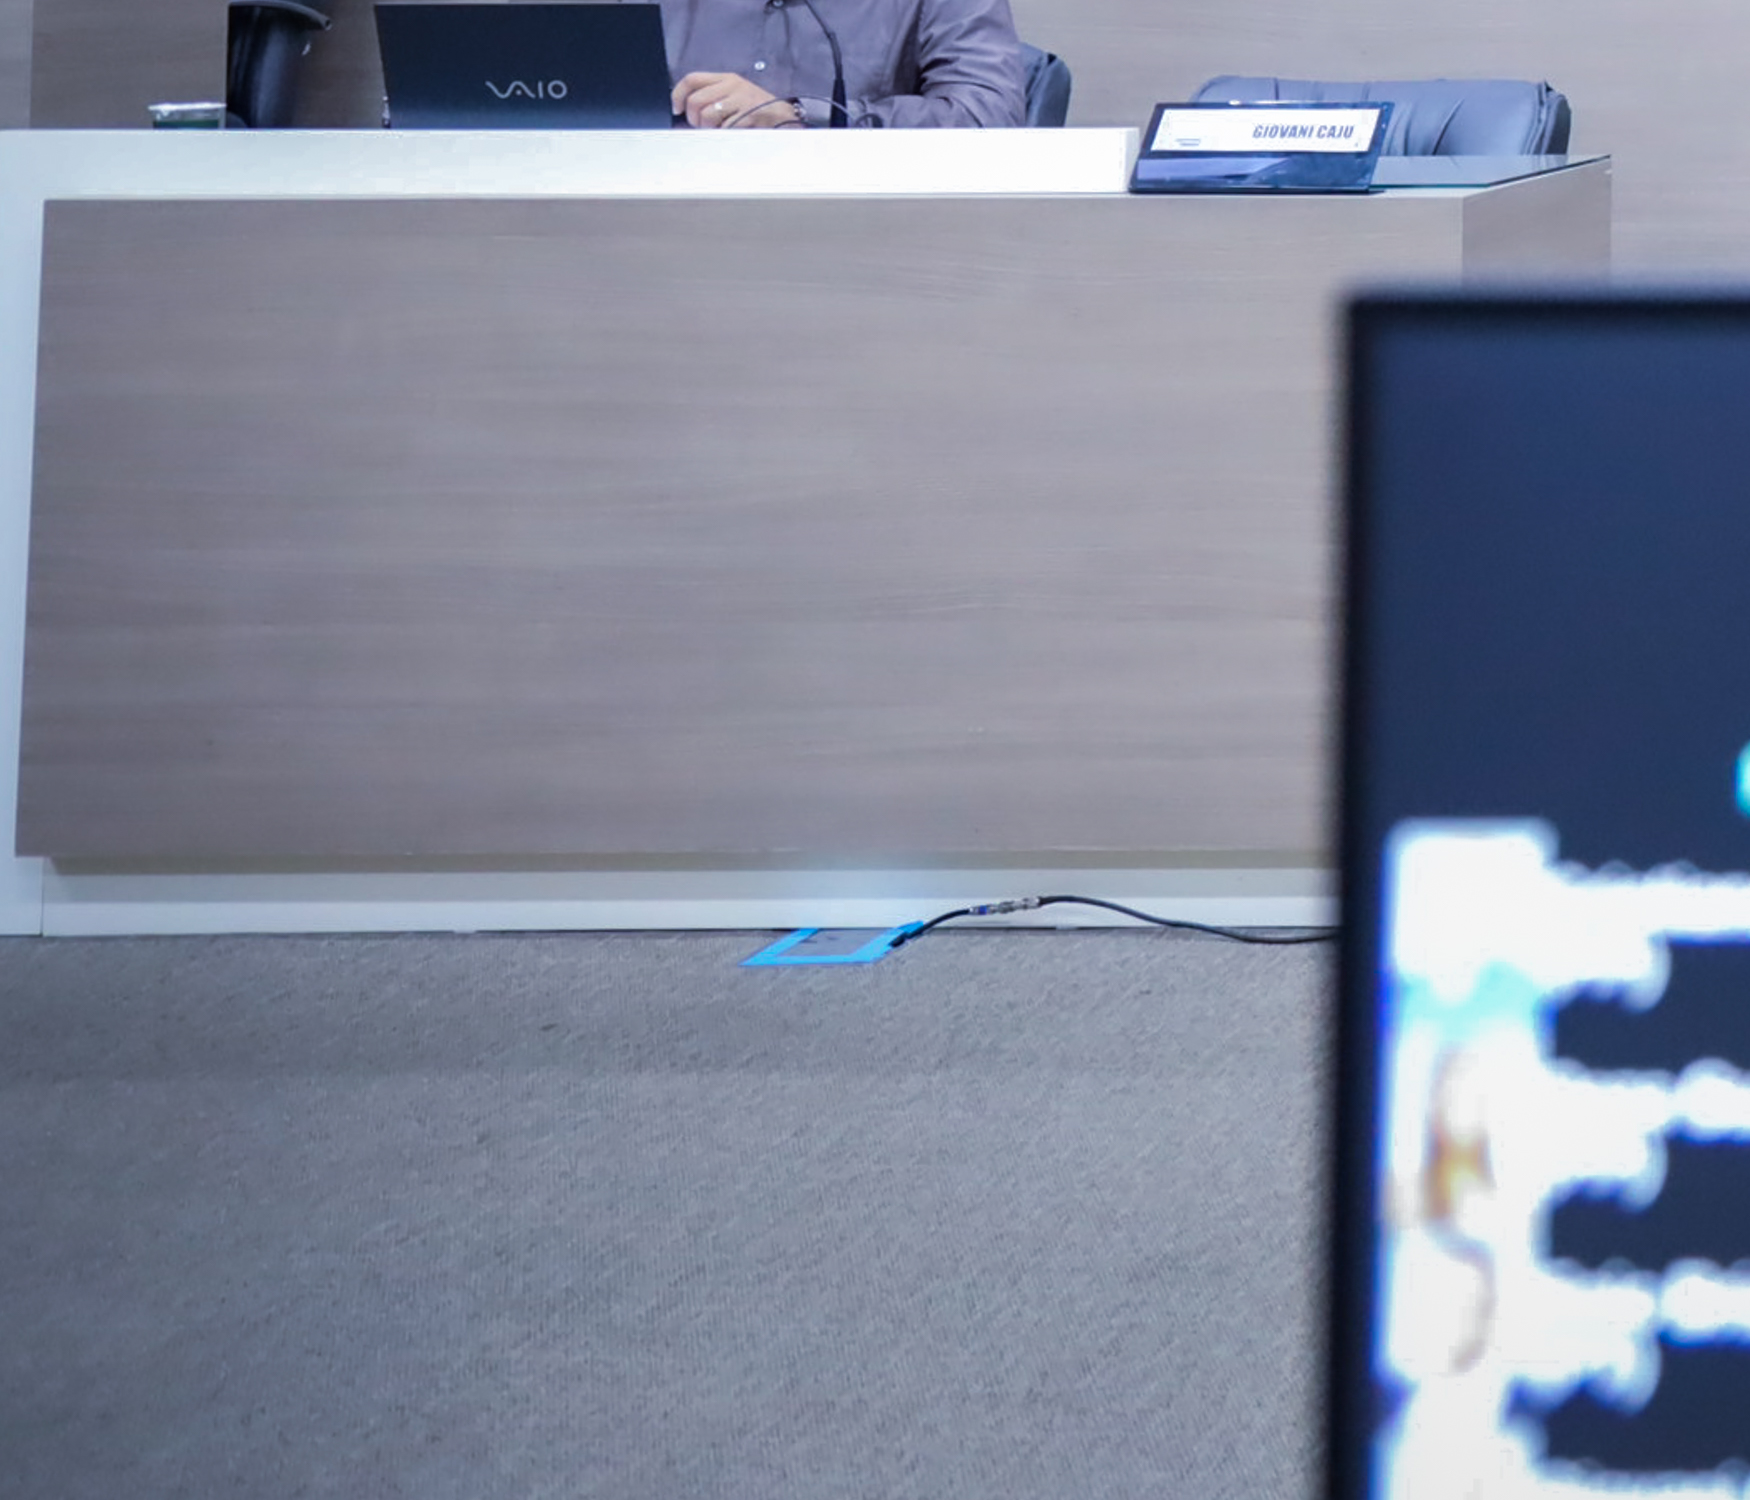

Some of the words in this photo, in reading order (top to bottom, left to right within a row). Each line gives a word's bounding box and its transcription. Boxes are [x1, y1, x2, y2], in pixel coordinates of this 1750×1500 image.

[485, 80, 567, 99] VAIO
[1252, 125, 1315, 139] GIOVANI
[1316, 125, 1355, 139] CAJU
